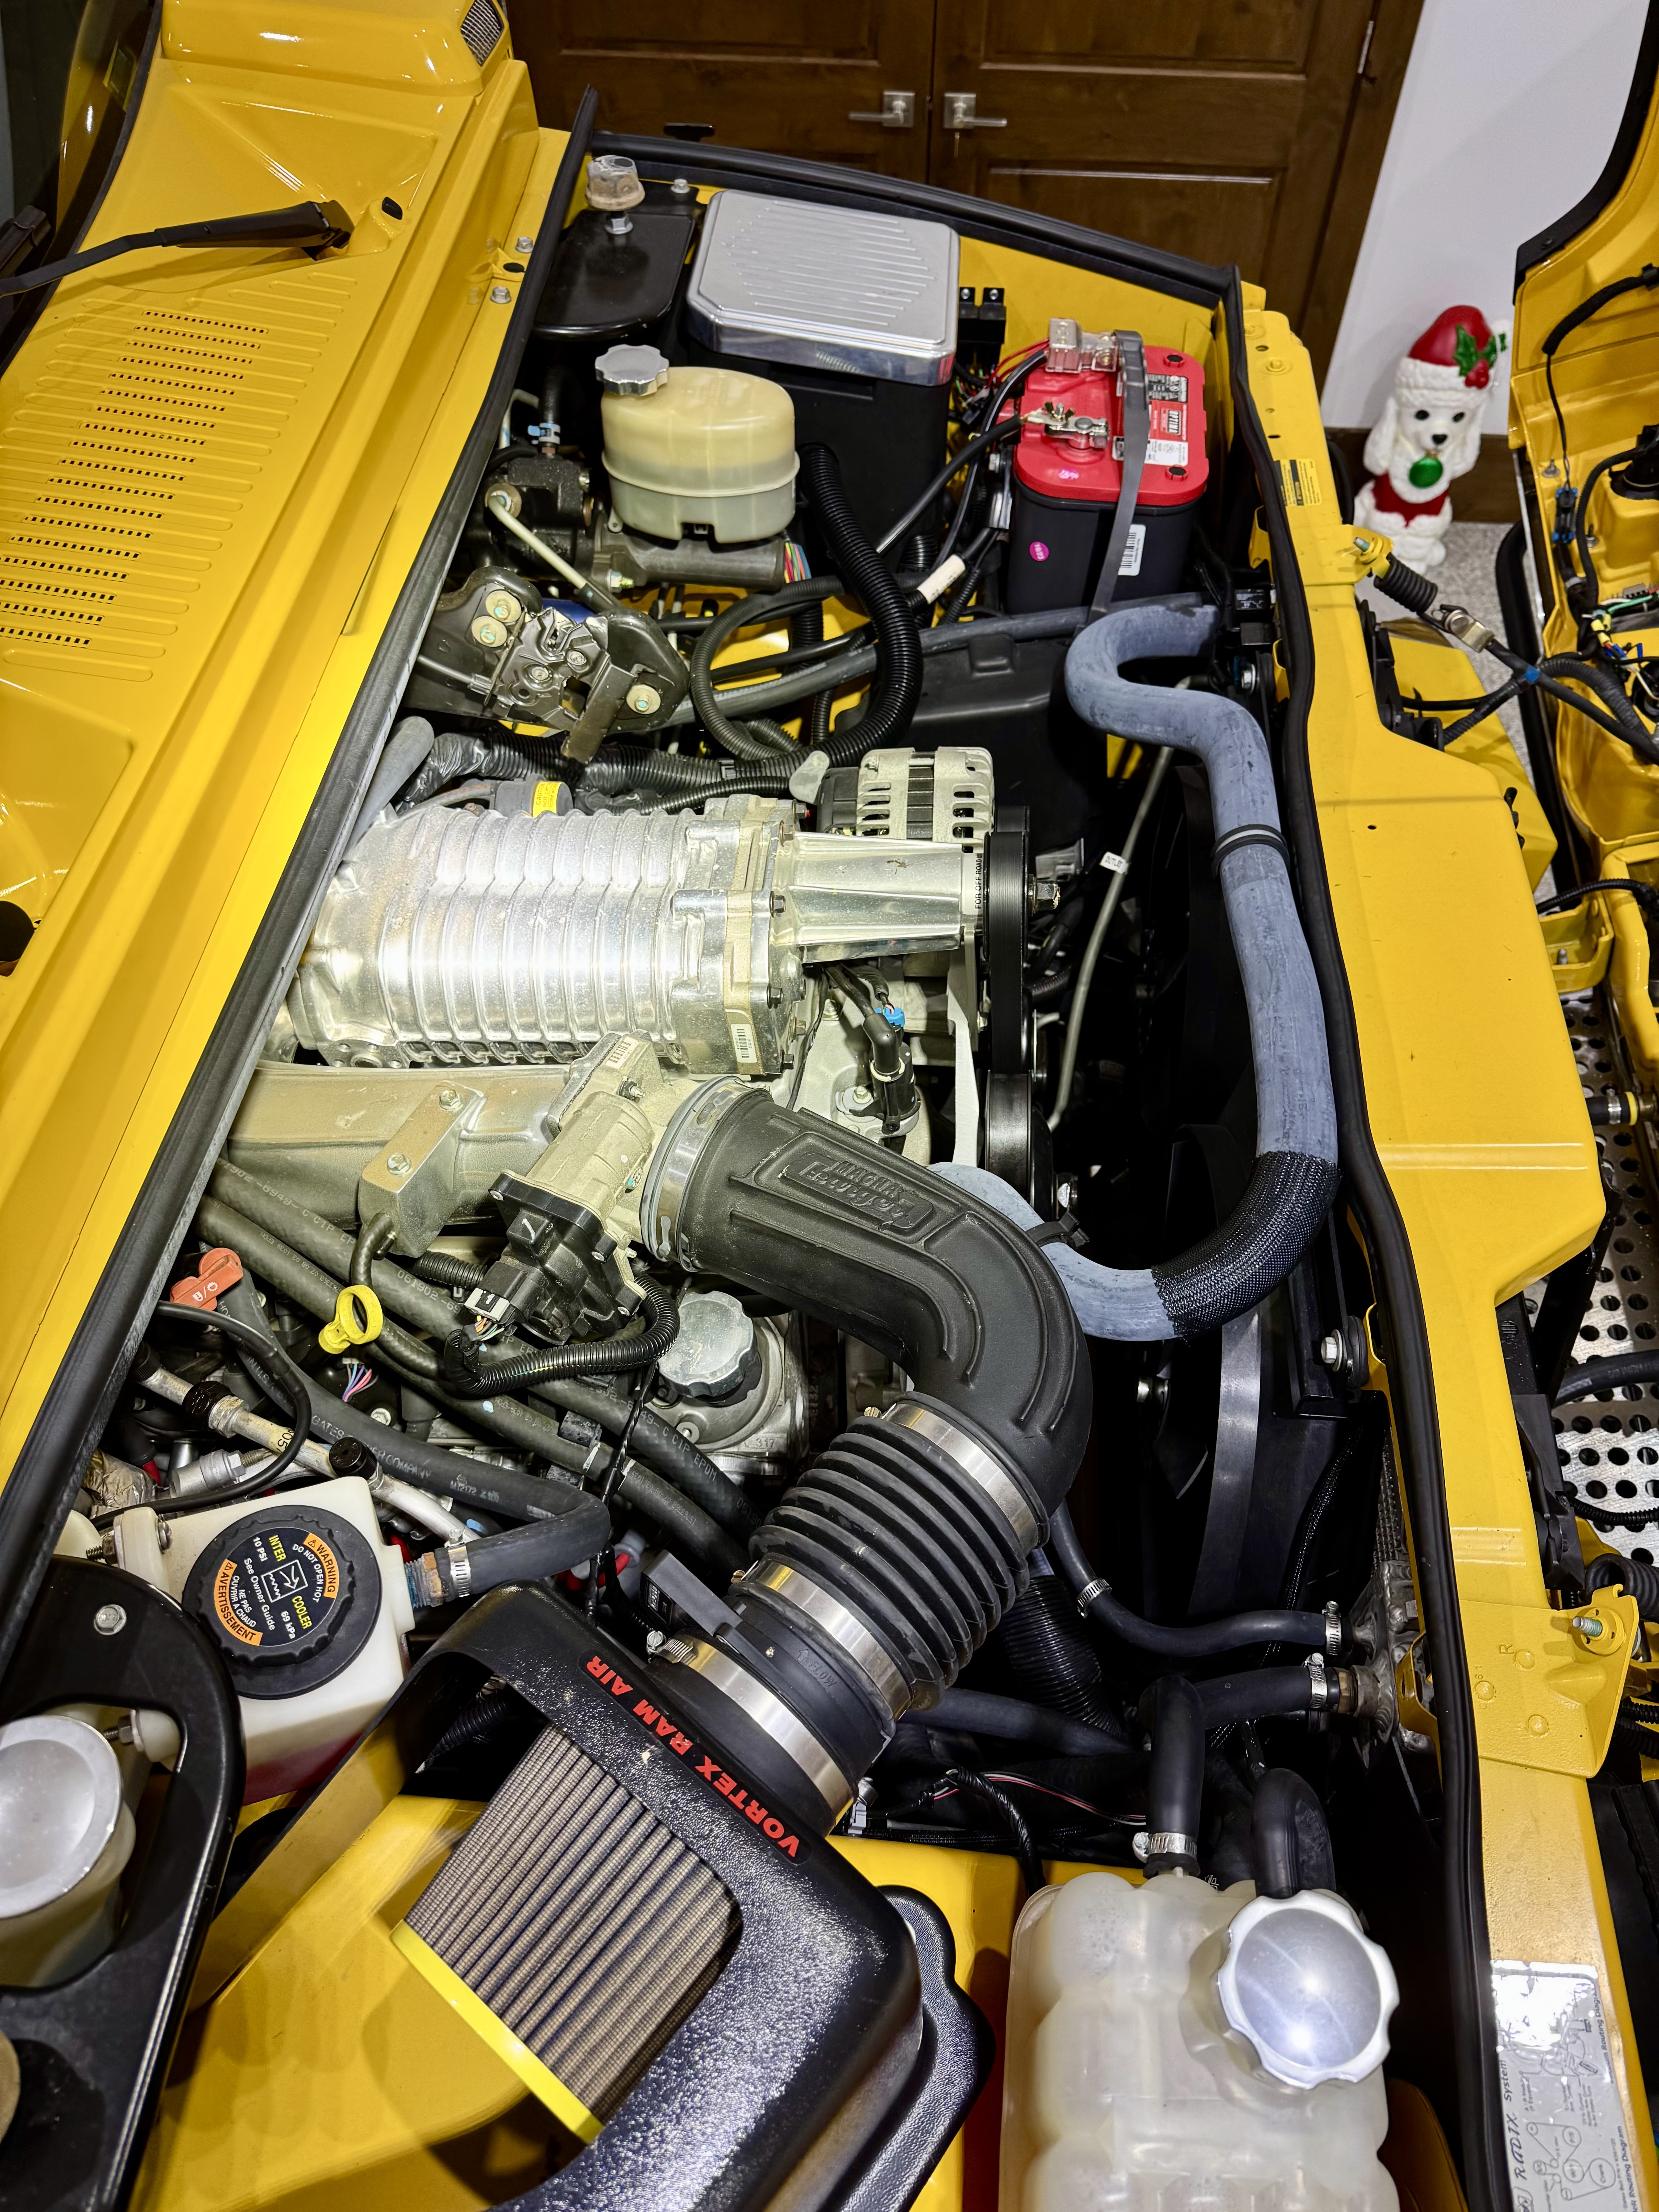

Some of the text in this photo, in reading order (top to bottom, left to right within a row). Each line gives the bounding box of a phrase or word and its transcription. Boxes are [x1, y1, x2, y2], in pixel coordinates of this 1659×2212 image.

[1104, 855, 1123, 867] OUTLET
[302, 1209, 310, 1217] C
[313, 1216, 335, 1233] CIP
[397, 1270, 439, 1300] 061902
[311, 1415, 432, 1480] GATES COMPANY
[663, 1427, 670, 1437] C
[672, 1436, 691, 1454] CIP
[693, 1456, 718, 1481] EPDM
[756, 1438, 775, 1448] 317
[253, 1537, 268, 1561] 10 PSI
[269, 1534, 286, 1561] INTER
[292, 1544, 324, 1603] DO NOT OPEN HOT
[316, 1544, 335, 1592] WARNING
[218, 1572, 256, 1641] AVERTISSEMENT
[230, 1576, 240, 1602] OUVRIR
[236, 1609, 256, 1628] CHAUD
[239, 1590, 252, 1613] NE PAS
[244, 1558, 275, 1630] See Owner Guide
[281, 1611, 295, 1639] 69 kPa
[292, 1595, 312, 1630] COOLER
[1498, 1644, 1514, 1654] R
[805, 1659, 840, 1690] FLOW
[586, 1656, 799, 1858] VORTEX RAM AIR
[1598, 2019, 1607, 2051] Routing
[1500, 2060, 1513, 2102] System
